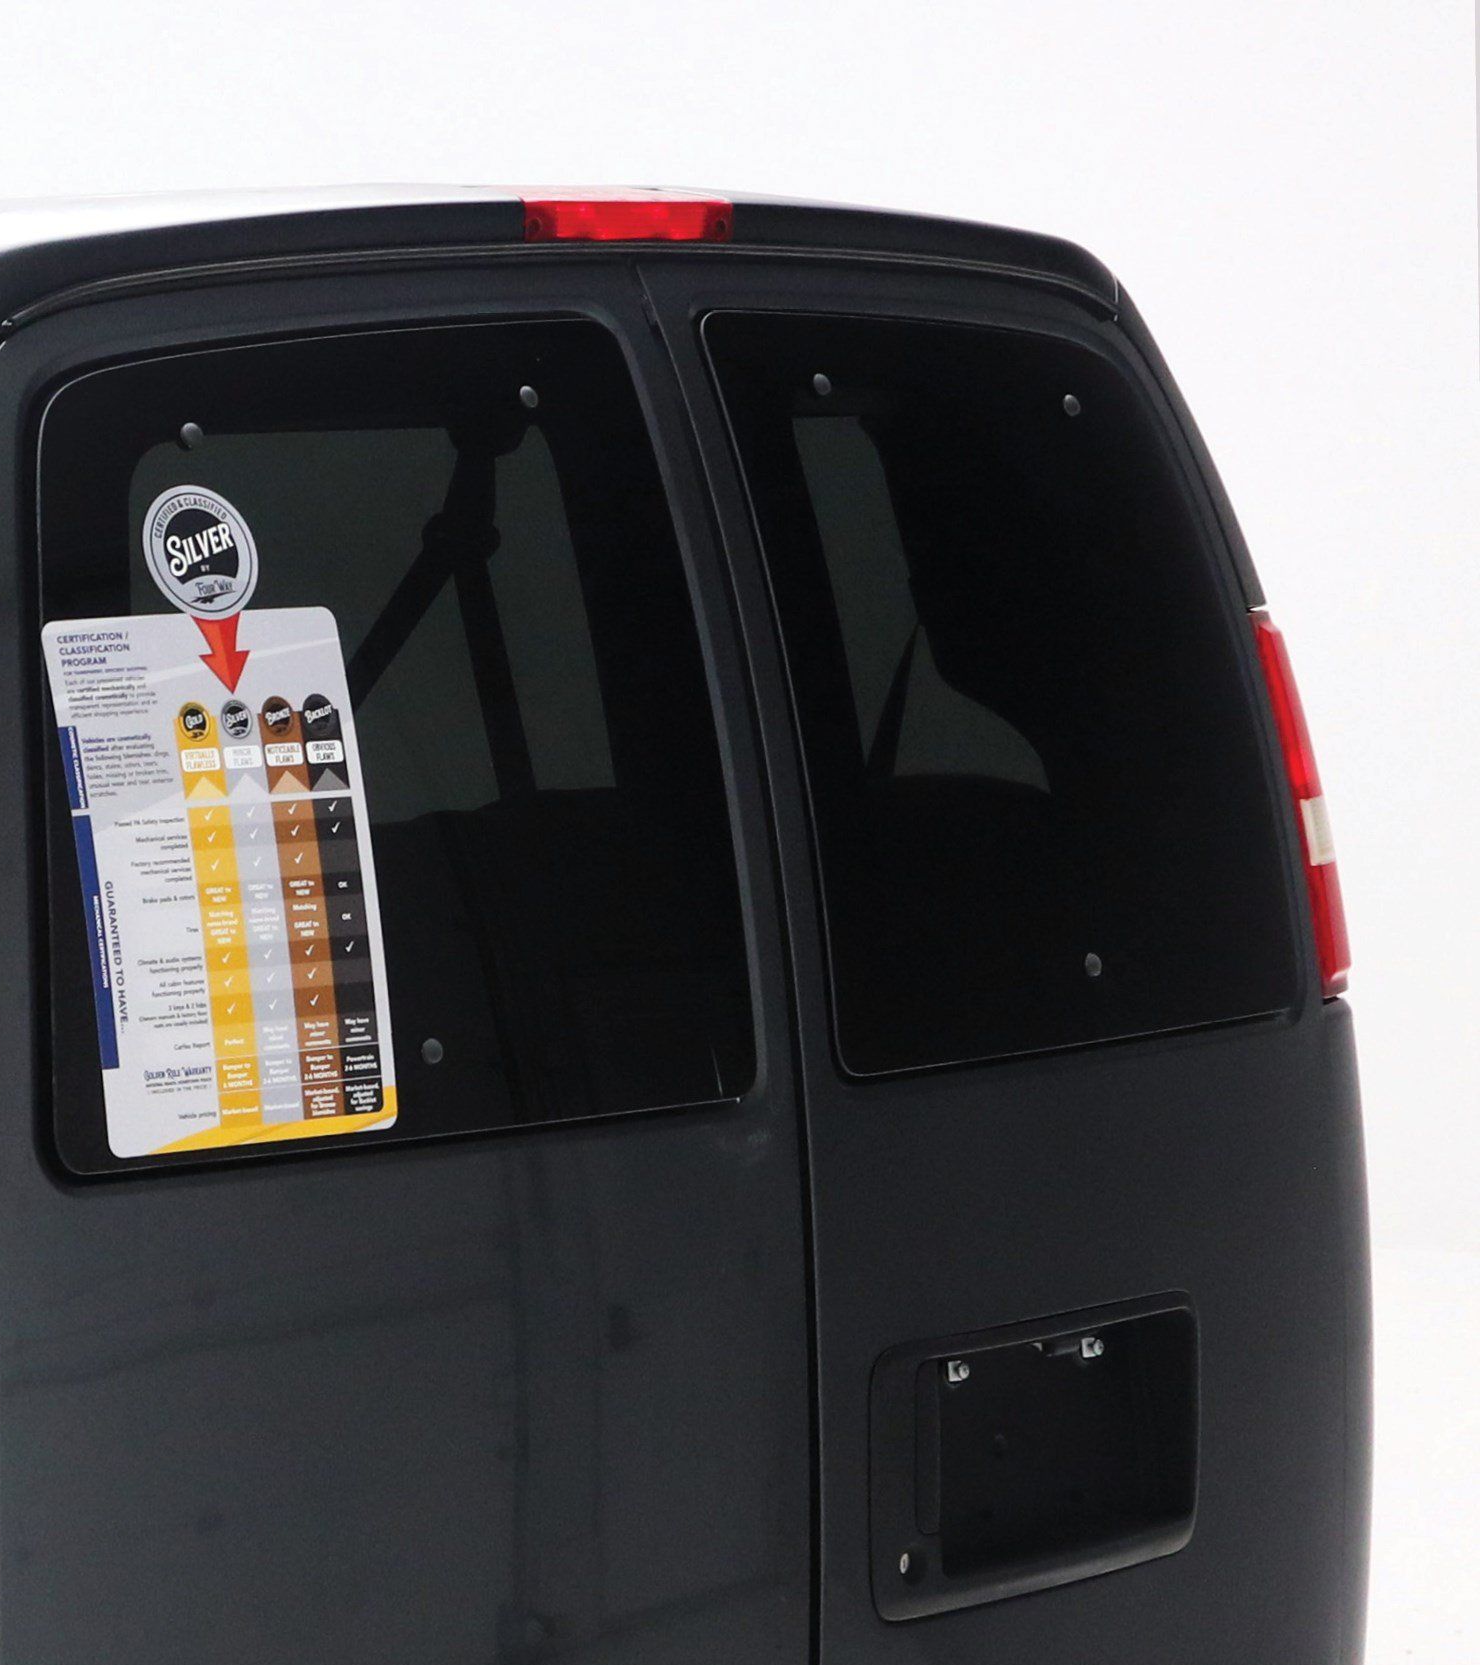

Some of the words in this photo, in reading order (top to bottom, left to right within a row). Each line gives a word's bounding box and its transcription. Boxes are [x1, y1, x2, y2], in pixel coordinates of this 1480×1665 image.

[154, 502, 178, 539] CERTIFIED
[183, 498, 227, 520] CLASSIFIED
[166, 522, 234, 577] SILVER
[57, 632, 123, 644] CERTIFICATION
[59, 643, 130, 656] CLASSIFICATION
[61, 657, 107, 667] PROGRAM
[186, 713, 203, 729] GOLD
[105, 881, 122, 966] GUARANTEED
[116, 969, 124, 986] TO
[181, 1066, 212, 1077] WARRANTY
